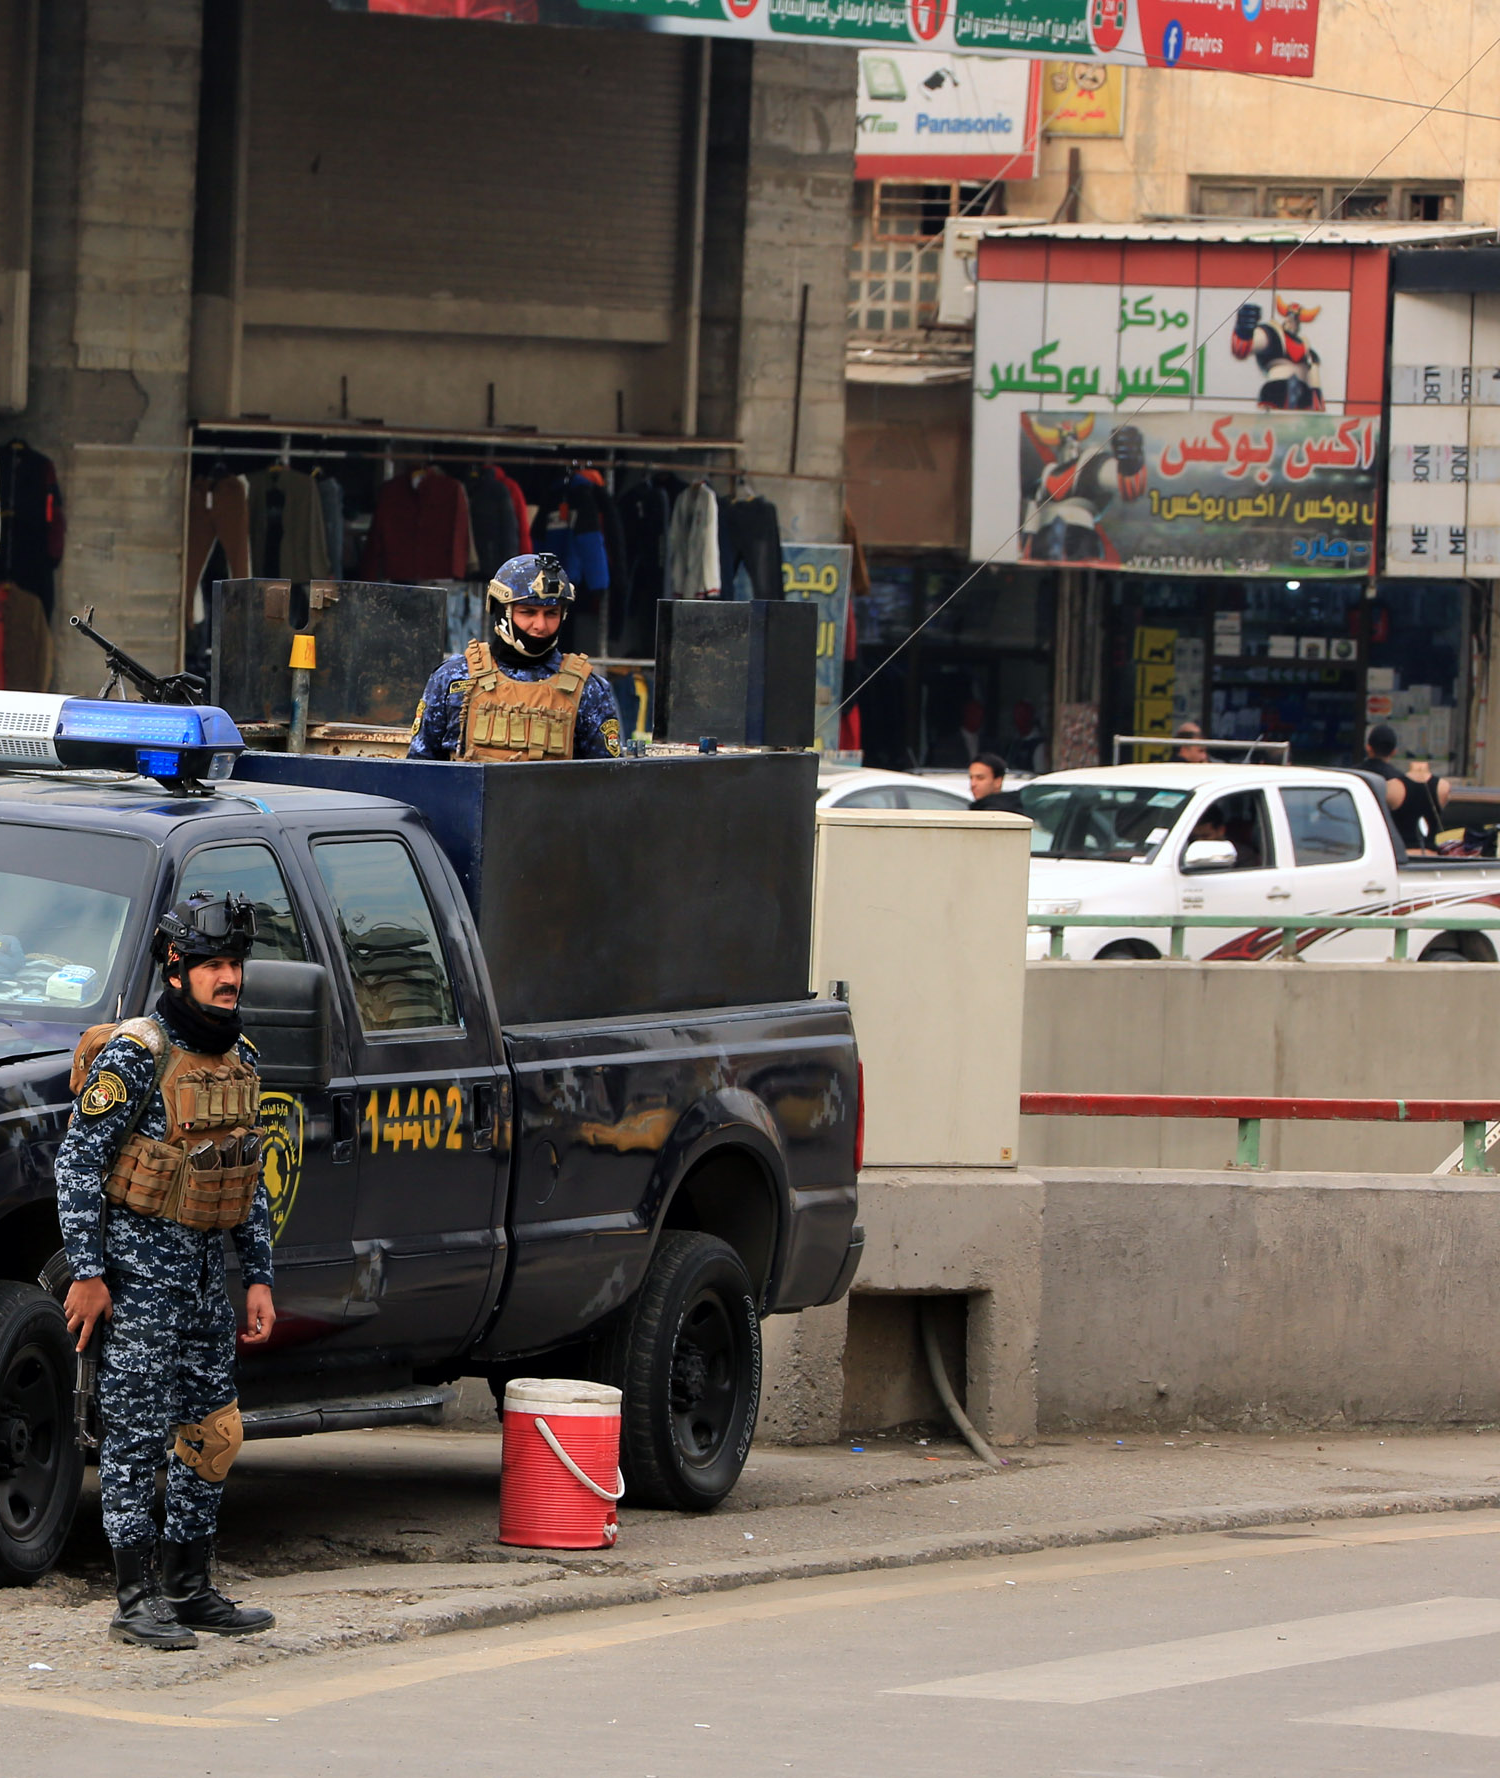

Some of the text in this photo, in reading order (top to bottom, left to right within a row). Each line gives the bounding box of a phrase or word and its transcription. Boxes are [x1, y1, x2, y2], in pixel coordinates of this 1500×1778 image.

[1185, 32, 1225, 57] iraqircs
[1272, 36, 1310, 62] iraqircs
[916, 113, 1013, 134] Panasonic
[1118, 295, 1189, 333] مركز
[1107, 342, 1206, 405] اكس
[1159, 414, 1374, 484] اكس بوكس
[365, 1086, 462, 1154] 14402
